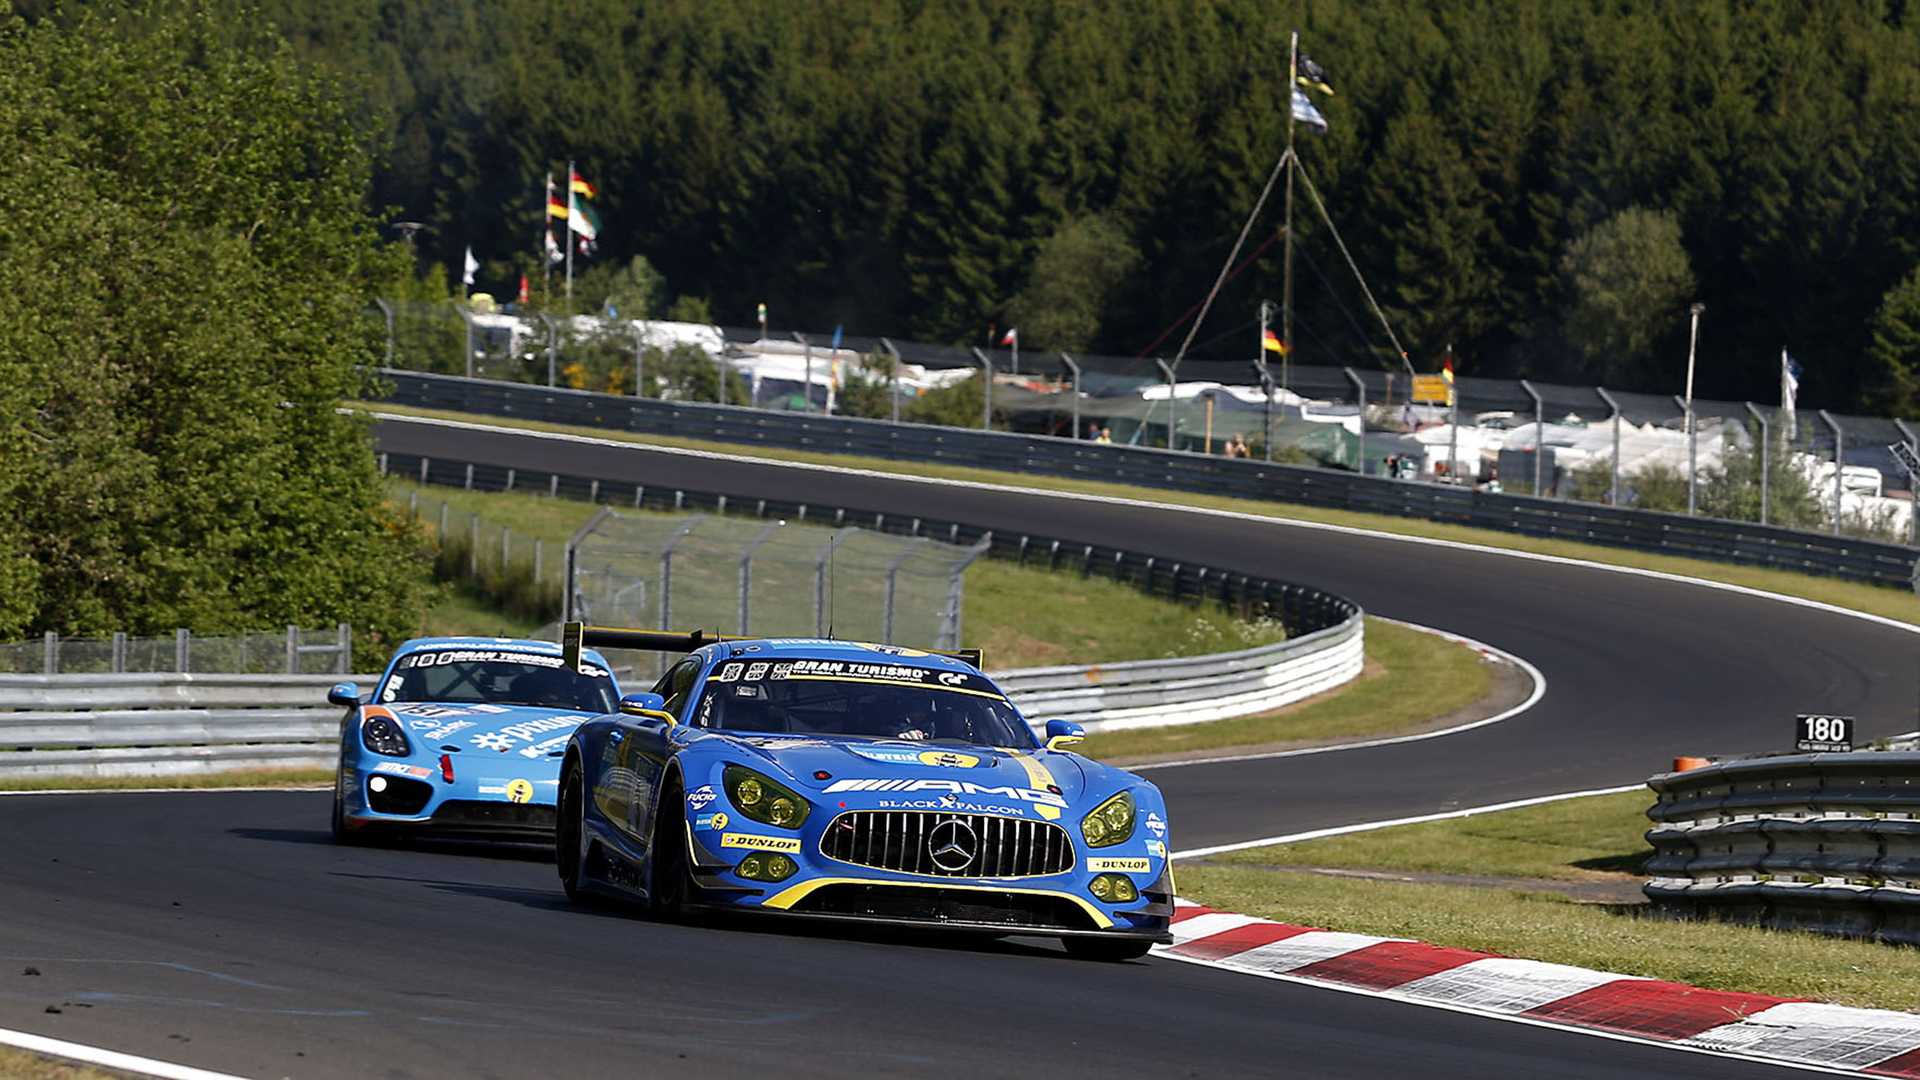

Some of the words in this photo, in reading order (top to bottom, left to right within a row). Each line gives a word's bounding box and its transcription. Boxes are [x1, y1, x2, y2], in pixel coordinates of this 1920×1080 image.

[793, 660, 844, 672] GRAN
[848, 663, 924, 679] TURISMO
[499, 715, 591, 742] pixum
[1805, 717, 1845, 742] 180
[879, 799, 938, 809] BLACK
[735, 837, 797, 850] DUNLOP
[1101, 860, 1148, 869] DUNLOP
